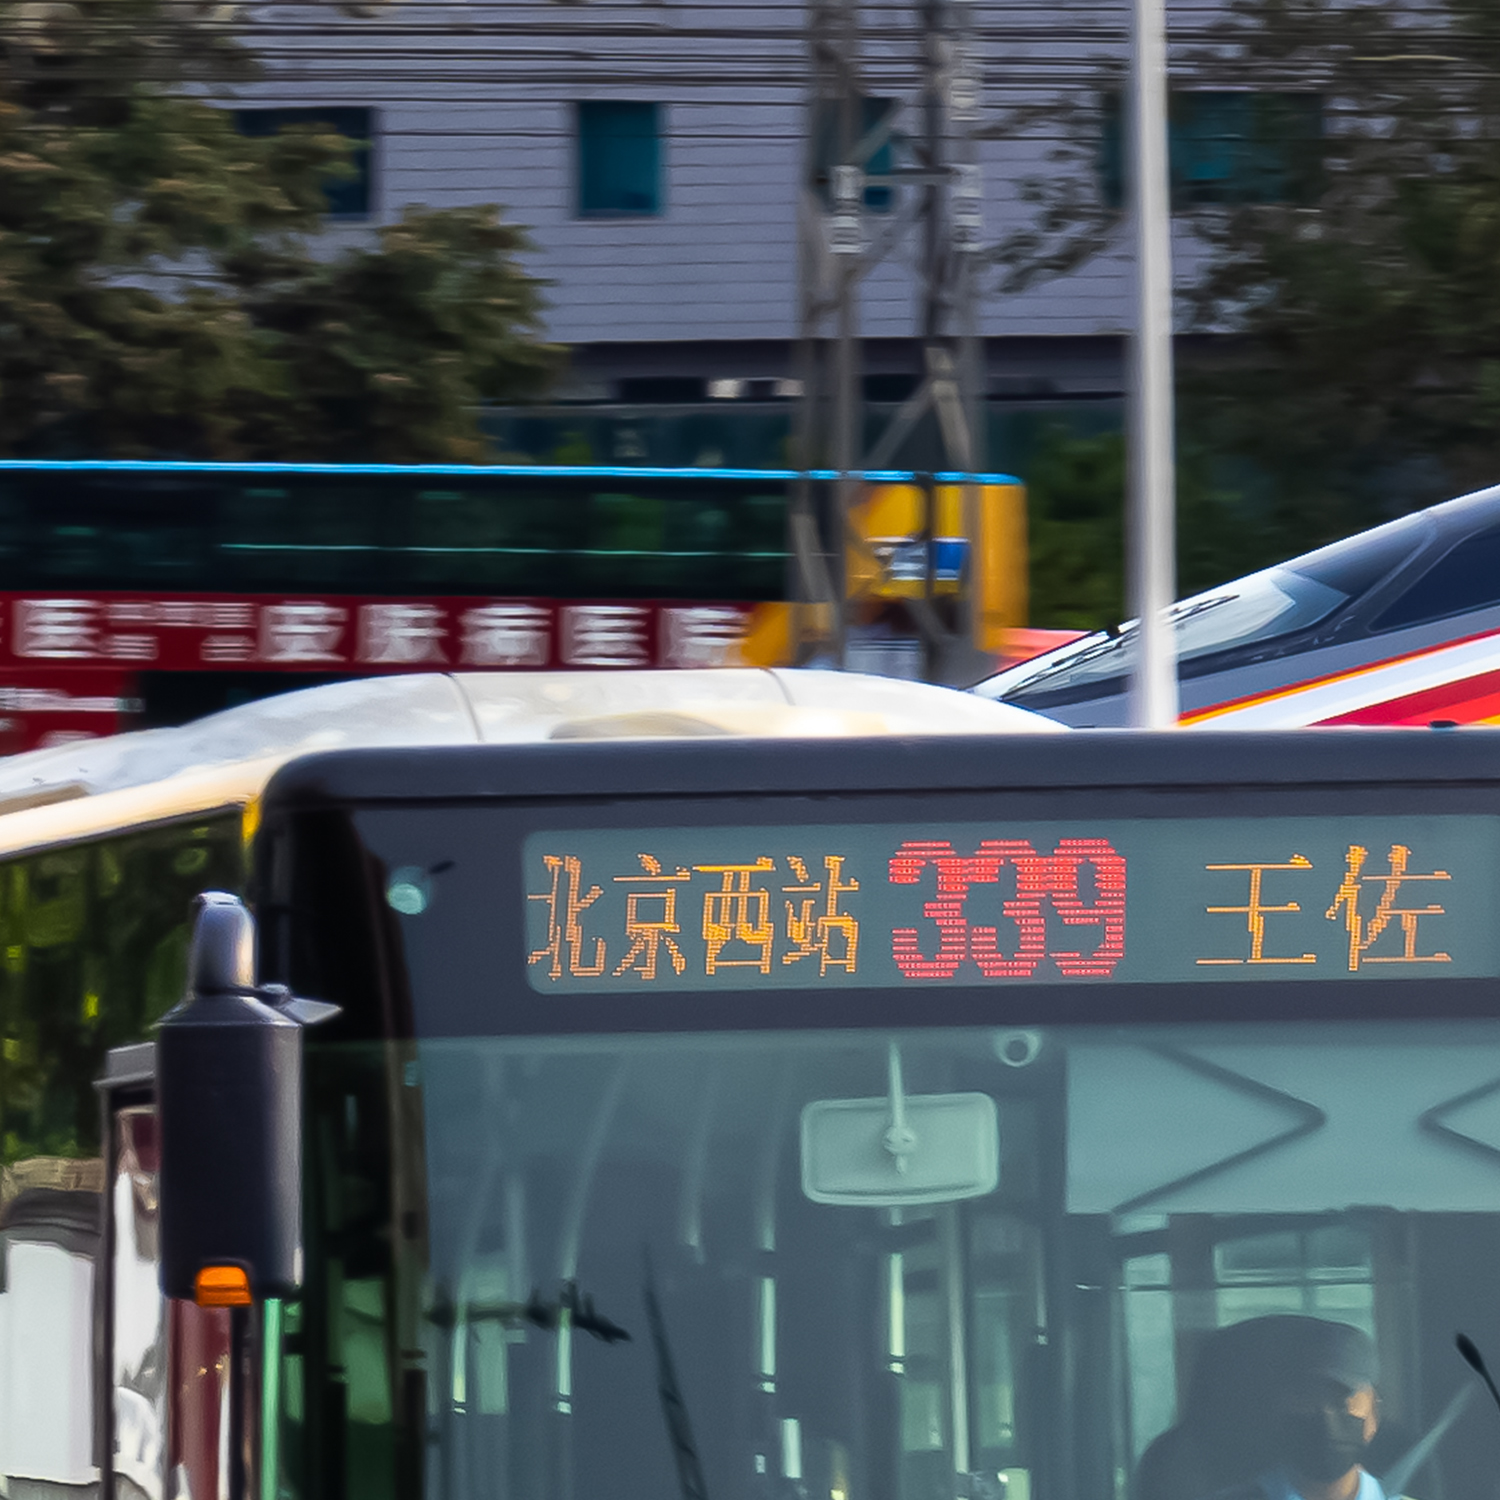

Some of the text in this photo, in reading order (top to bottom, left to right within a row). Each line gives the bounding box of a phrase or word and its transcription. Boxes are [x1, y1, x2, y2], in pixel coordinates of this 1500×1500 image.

[526, 839, 1453, 980] 北京西站 339 王佐
